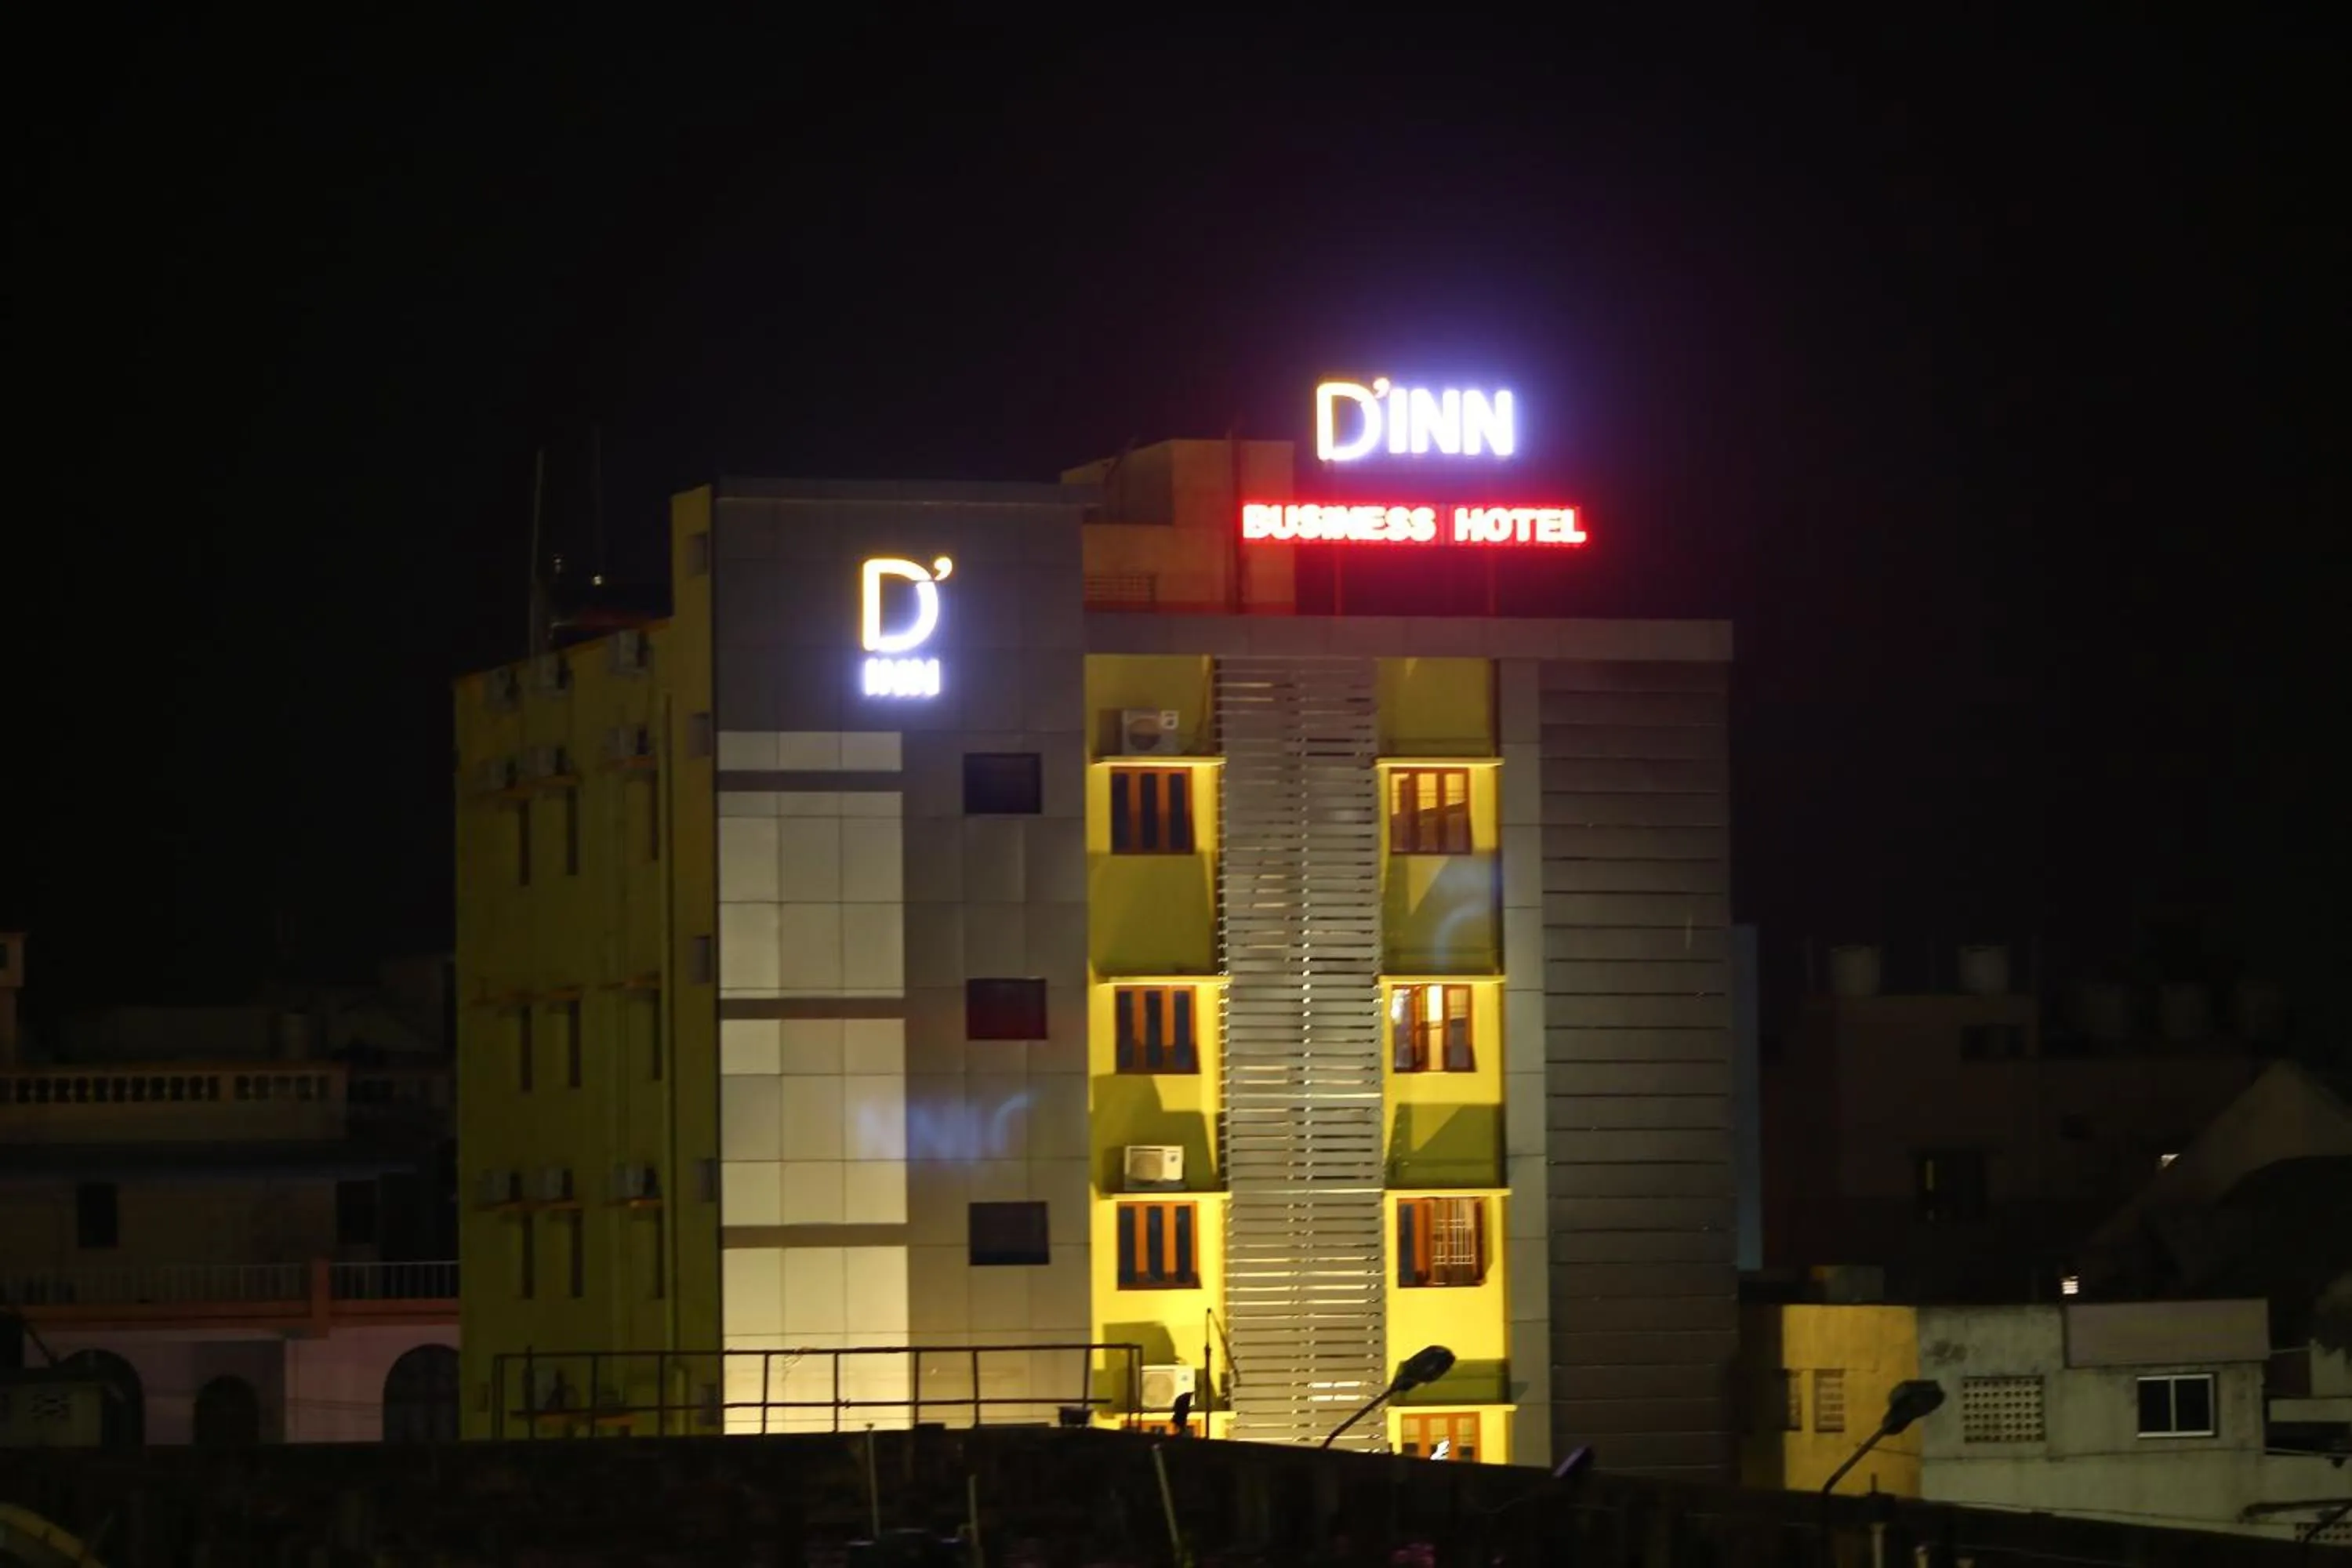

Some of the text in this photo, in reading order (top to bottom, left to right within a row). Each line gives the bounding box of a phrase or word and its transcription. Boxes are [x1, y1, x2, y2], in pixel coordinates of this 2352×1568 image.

[1317, 378, 1515, 461] D'INN
[1243, 504, 1585, 543] BUSINESS HOTEL
